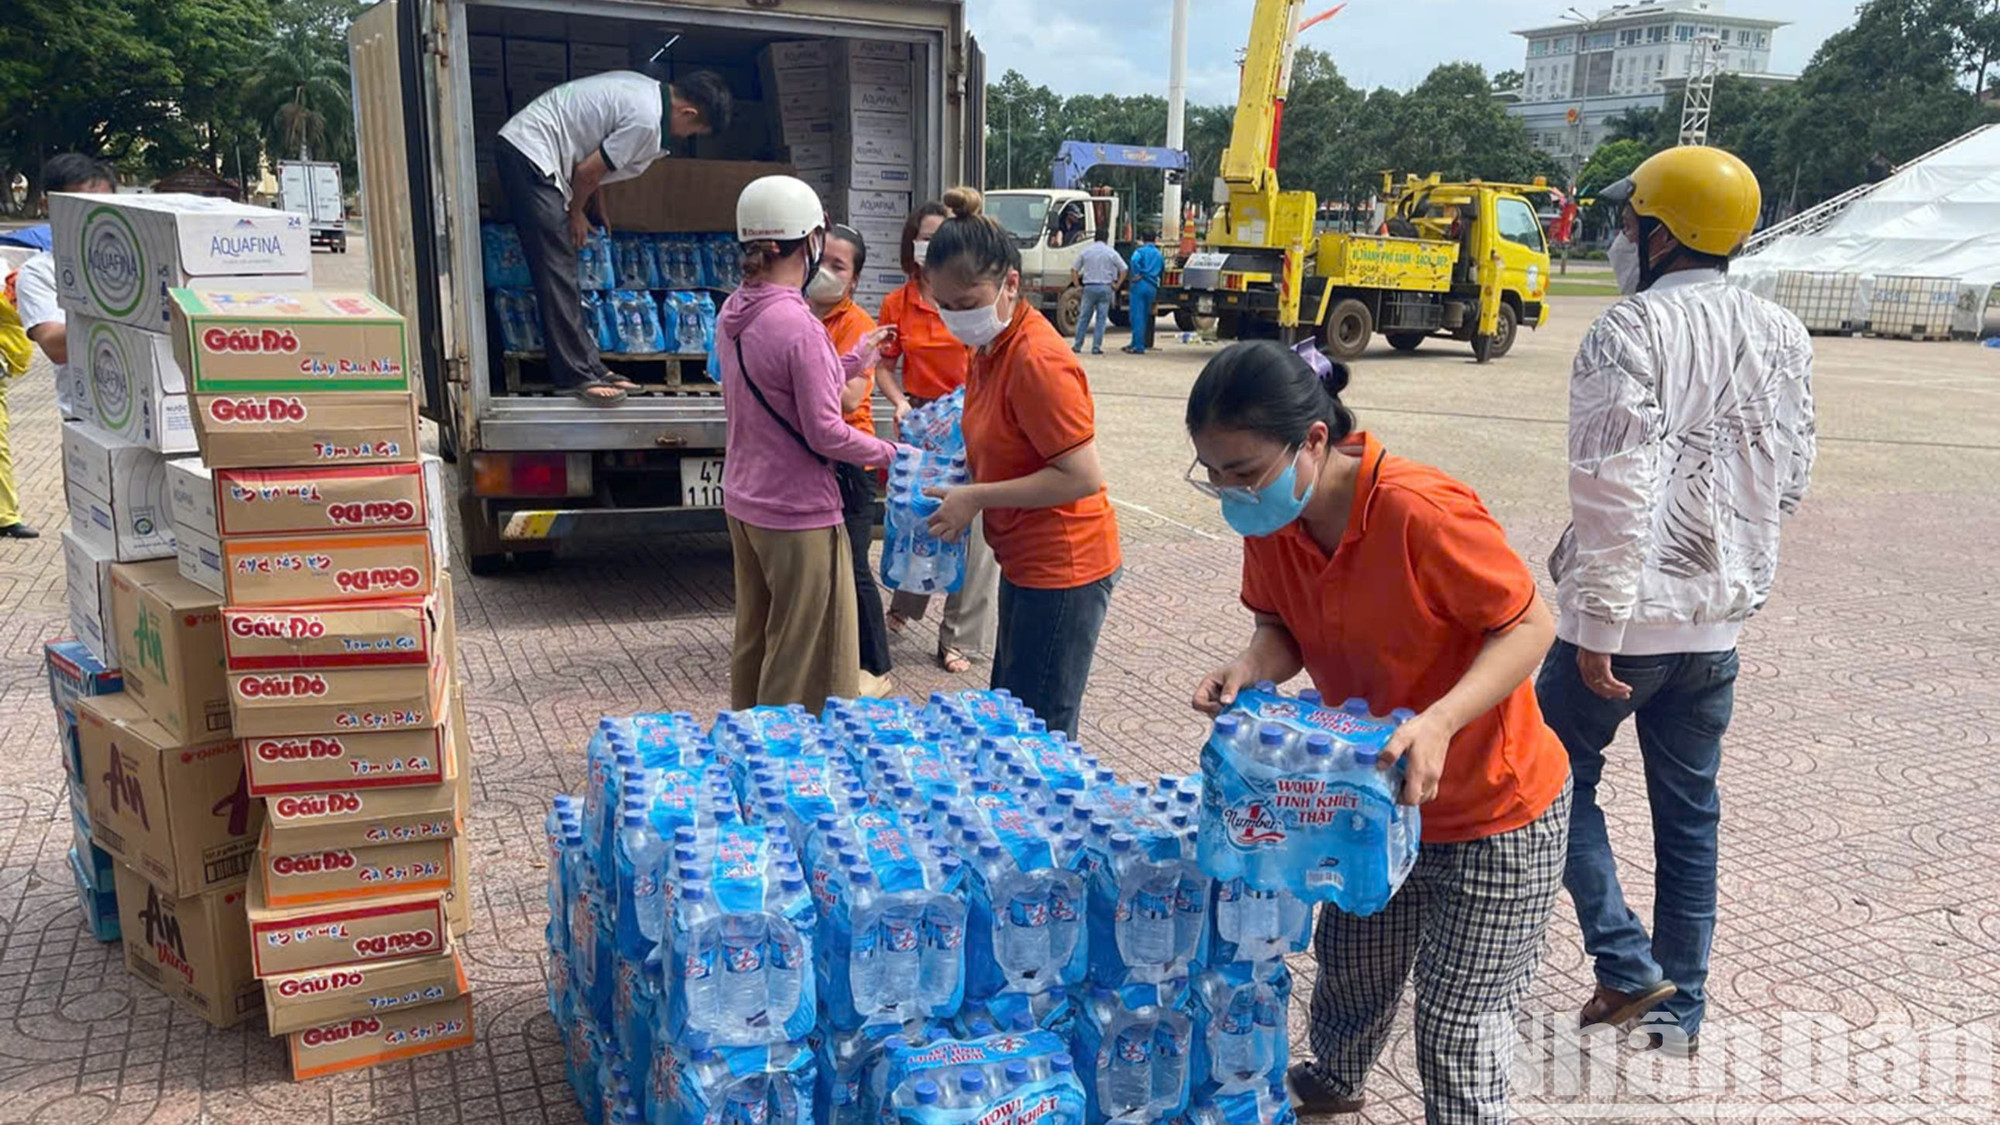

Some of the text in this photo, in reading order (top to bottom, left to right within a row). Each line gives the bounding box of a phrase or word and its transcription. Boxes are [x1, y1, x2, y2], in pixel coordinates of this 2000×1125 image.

[288, 217, 301, 226] 24
[210, 236, 284, 258] AQUAFINA
[300, 359, 335, 376] Chay
[339, 359, 367, 372] Rau
[700, 461, 724, 483] 47
[1277, 780, 1326, 795] WOW!
[1275, 795, 1310, 808] TINH
